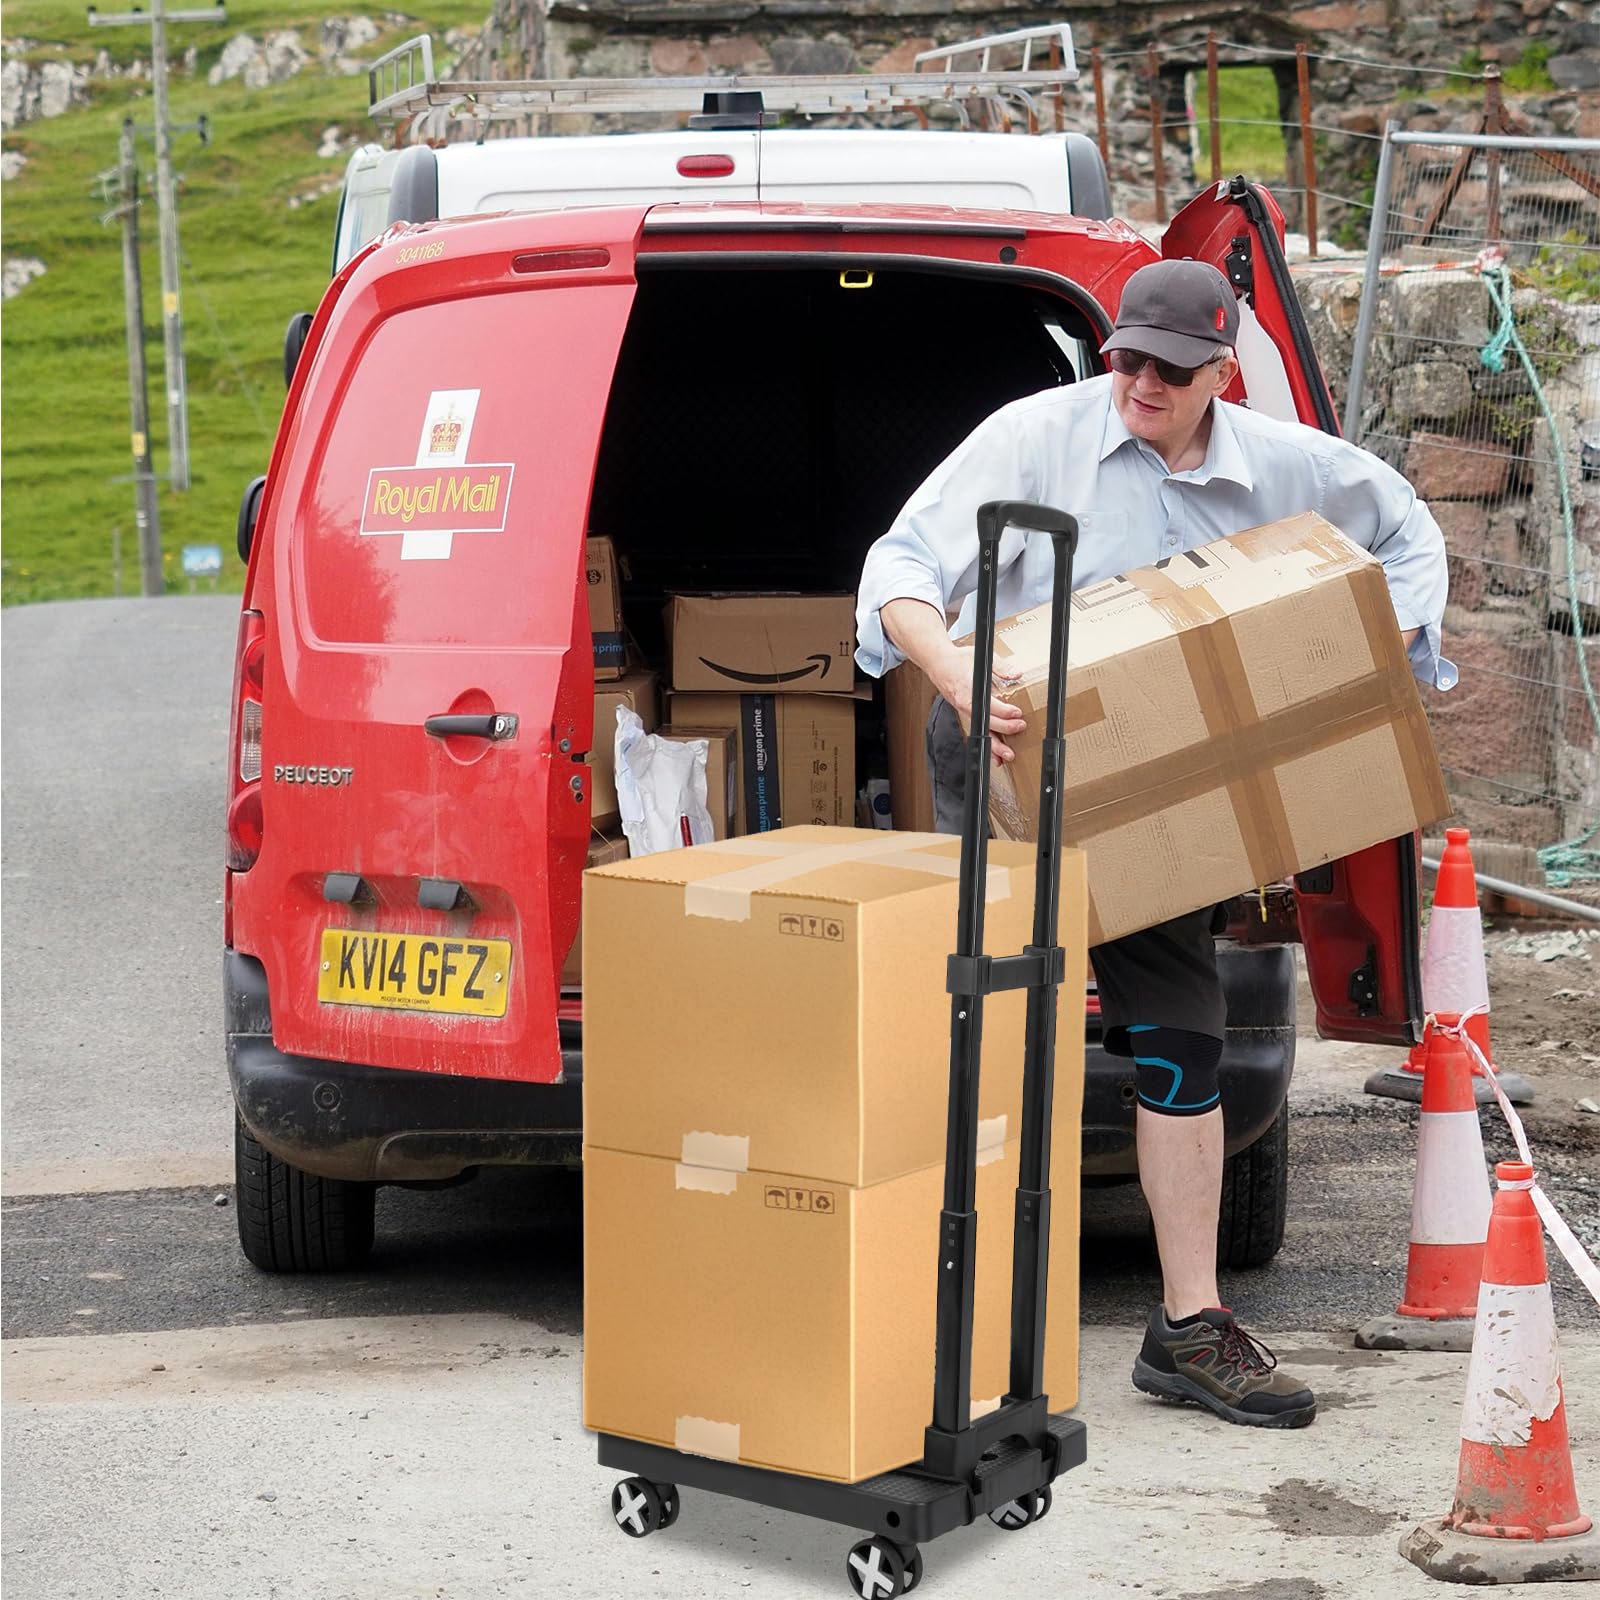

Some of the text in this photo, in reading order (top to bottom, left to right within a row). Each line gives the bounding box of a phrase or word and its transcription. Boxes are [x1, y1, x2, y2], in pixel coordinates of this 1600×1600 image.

[395, 241, 445, 264] 3041168
[373, 474, 501, 523] Royal Mail
[753, 708, 765, 738] prime
[755, 738, 767, 772] amazon
[274, 764, 354, 787] PEUGEOT
[756, 776, 768, 805] prime
[338, 935, 489, 1000] KV14 GFZ
